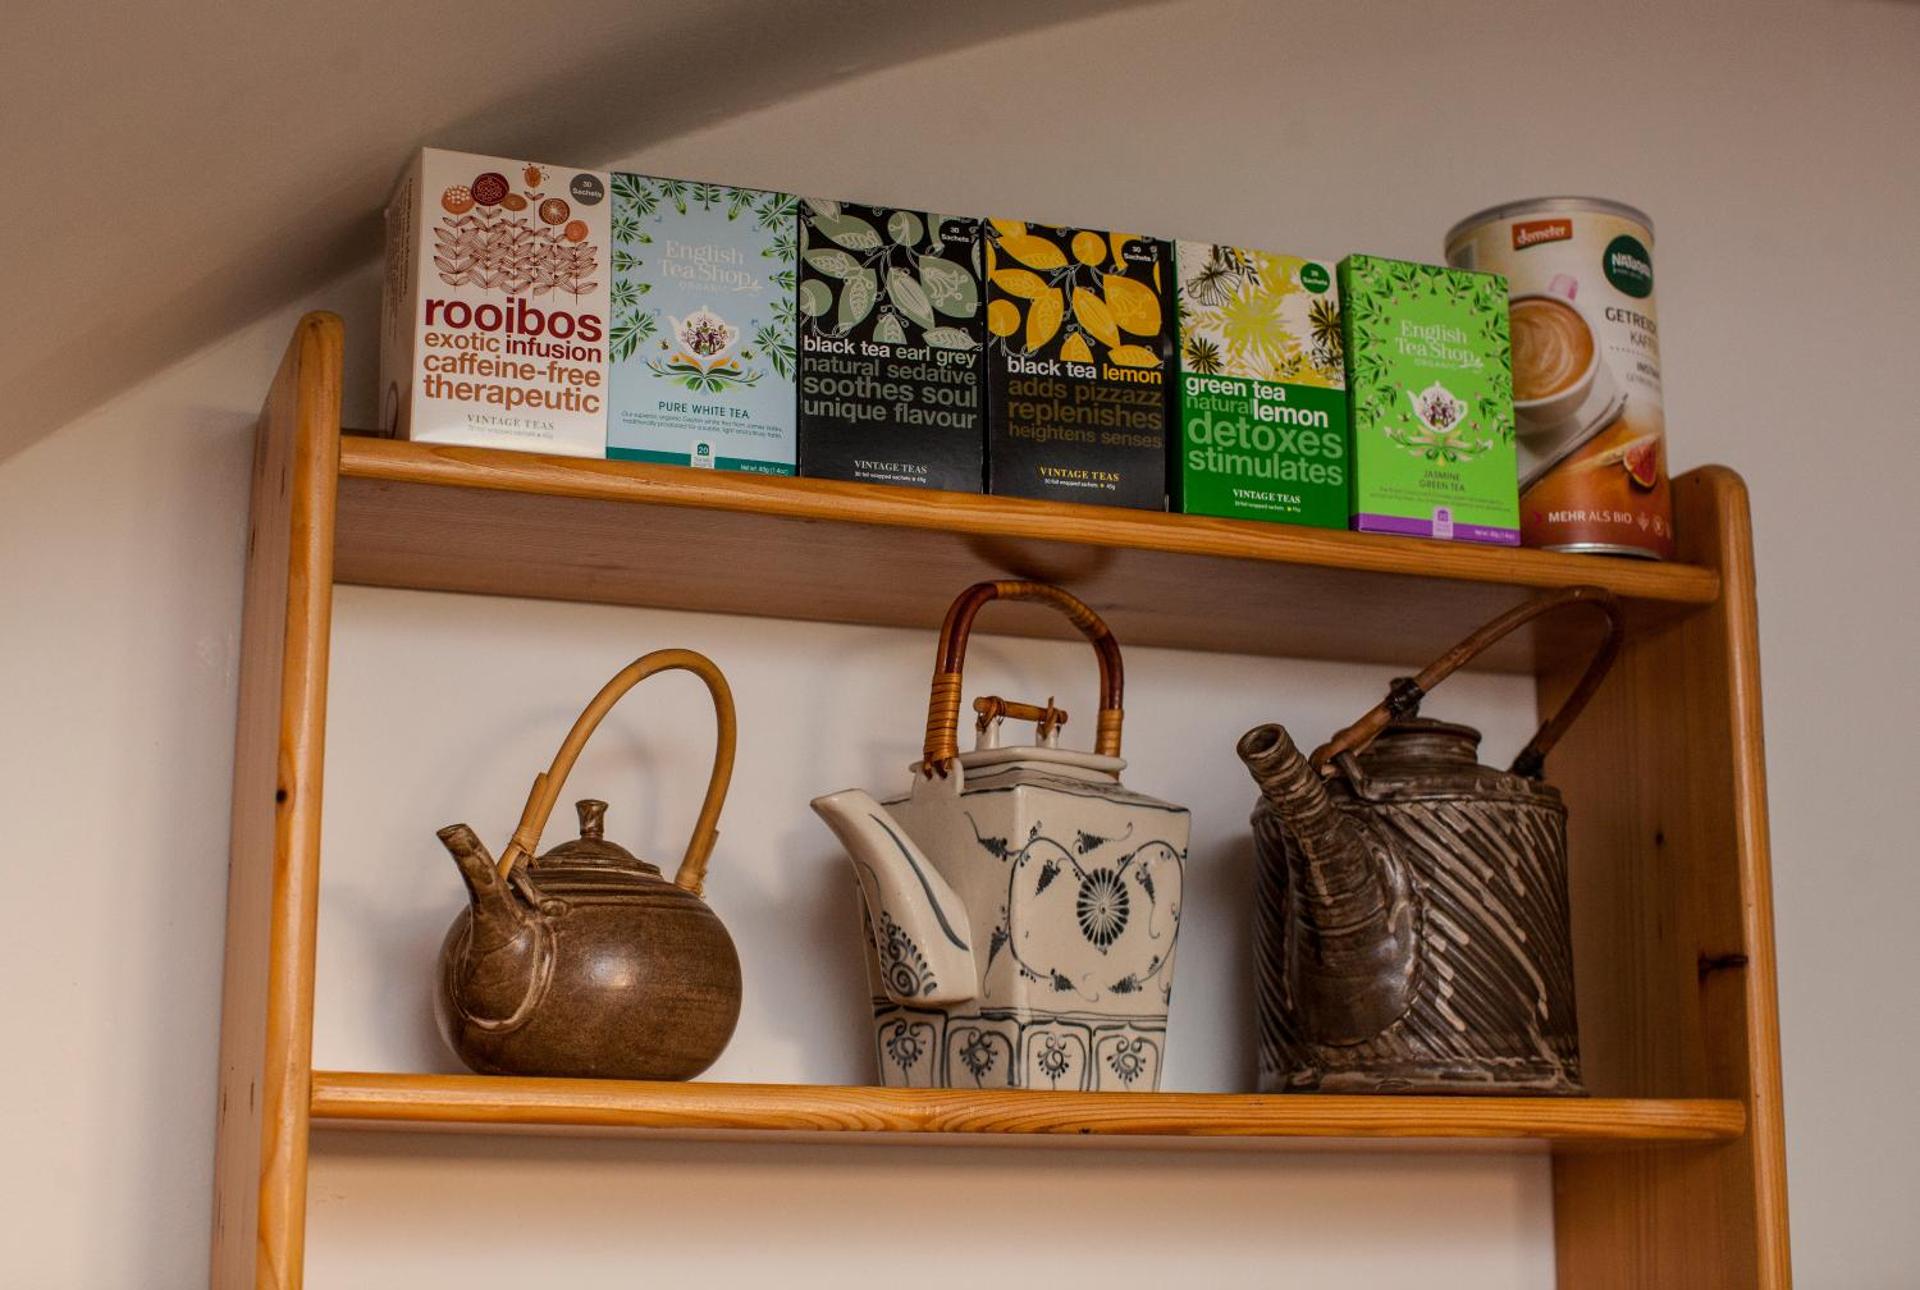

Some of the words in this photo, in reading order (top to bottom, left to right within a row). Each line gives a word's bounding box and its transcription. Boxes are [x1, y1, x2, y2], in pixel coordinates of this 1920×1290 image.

[941, 233, 970, 243] Sachets
[1517, 225, 1566, 245] demeter
[664, 240, 744, 265] English
[1124, 253, 1152, 262] Sachets
[659, 259, 696, 280] Tea
[698, 263, 752, 287] Shop
[424, 297, 602, 342] rooibos
[1401, 319, 1468, 345] English
[424, 332, 500, 352] exotic
[506, 334, 602, 363] infusion
[803, 334, 856, 355] black
[860, 341, 890, 358] tea
[896, 346, 931, 362] earl
[936, 350, 976, 368] grey
[1395, 336, 1427, 357] Tea
[1430, 341, 1476, 368] Shop
[423, 352, 601, 388] caffeine-free
[804, 356, 880, 377] natural
[887, 363, 977, 385] sedative
[1007, 356, 1061, 377] black
[1066, 361, 1097, 379] tea
[1102, 363, 1162, 384] lemon
[423, 373, 600, 413] therapeutic
[804, 375, 914, 401] soothes
[921, 385, 977, 408] soul
[1008, 377, 1067, 399] adds
[1074, 381, 1163, 406] pizzazz
[1185, 376, 1247, 397] green
[1252, 381, 1286, 401] tea
[467, 414, 520, 428] VINTAGE
[523, 419, 554, 431] TEAS
[658, 401, 687, 413] PURE
[692, 405, 725, 417] WHITE
[730, 408, 750, 419] TEA
[804, 397, 887, 423] unique
[893, 403, 977, 429] flavour
[1007, 398, 1163, 430] replenishes
[1186, 394, 1253, 415] natural
[1253, 399, 1329, 428] lemon
[1008, 421, 1097, 442] heightens
[1097, 431, 1162, 448] senses
[1187, 410, 1343, 459] detoxes
[697, 445, 709, 456] 20
[854, 459, 900, 472] VINTAGE
[901, 463, 928, 474] TEAS
[1040, 466, 1089, 479] VINTAGE
[1091, 471, 1120, 482] TEAS
[1188, 446, 1343, 486] stimulates
[1424, 470, 1460, 481] JASMINE
[1233, 488, 1276, 501] VINTAGE
[1276, 493, 1301, 504] TEAS
[1418, 480, 1449, 490] GREEN
[1451, 483, 1465, 492] TEA
[1548, 511, 1586, 523] MEHR
[1588, 511, 1611, 523] ALS
[1613, 511, 1632, 524] BIO
